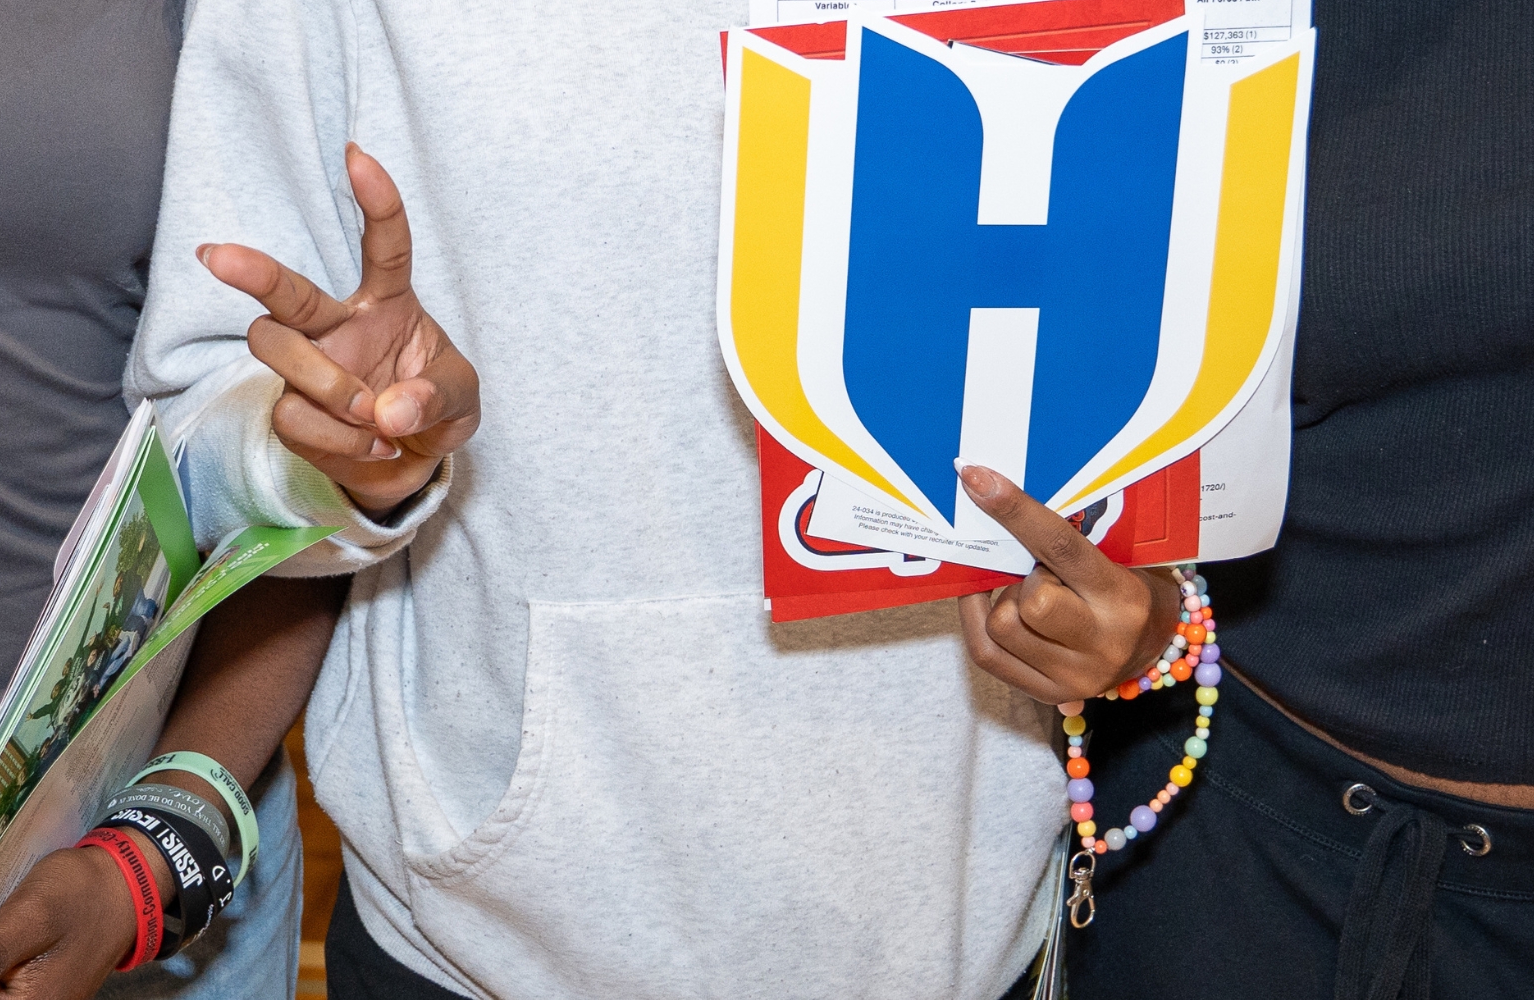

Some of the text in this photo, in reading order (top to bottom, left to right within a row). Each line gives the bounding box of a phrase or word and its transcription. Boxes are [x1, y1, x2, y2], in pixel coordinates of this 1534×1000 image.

[1203, 30, 1257, 41] $127,363 (1)
[1211, 45, 1243, 55] 93% (2)
[852, 505, 874, 514] 24-034
[853, 513, 889, 525] Information
[889, 521, 903, 529] may
[904, 523, 919, 531] have
[858, 522, 880, 531] Please
[880, 527, 899, 535] check
[929, 536, 954, 546] recruiter
[955, 540, 964, 548] for
[965, 542, 991, 553] updates.
[219, 770, 236, 792] CALL
[149, 794, 160, 803] BE
[161, 797, 173, 806] DO
[234, 790, 249, 816] GOOD
[175, 802, 191, 814] YOU
